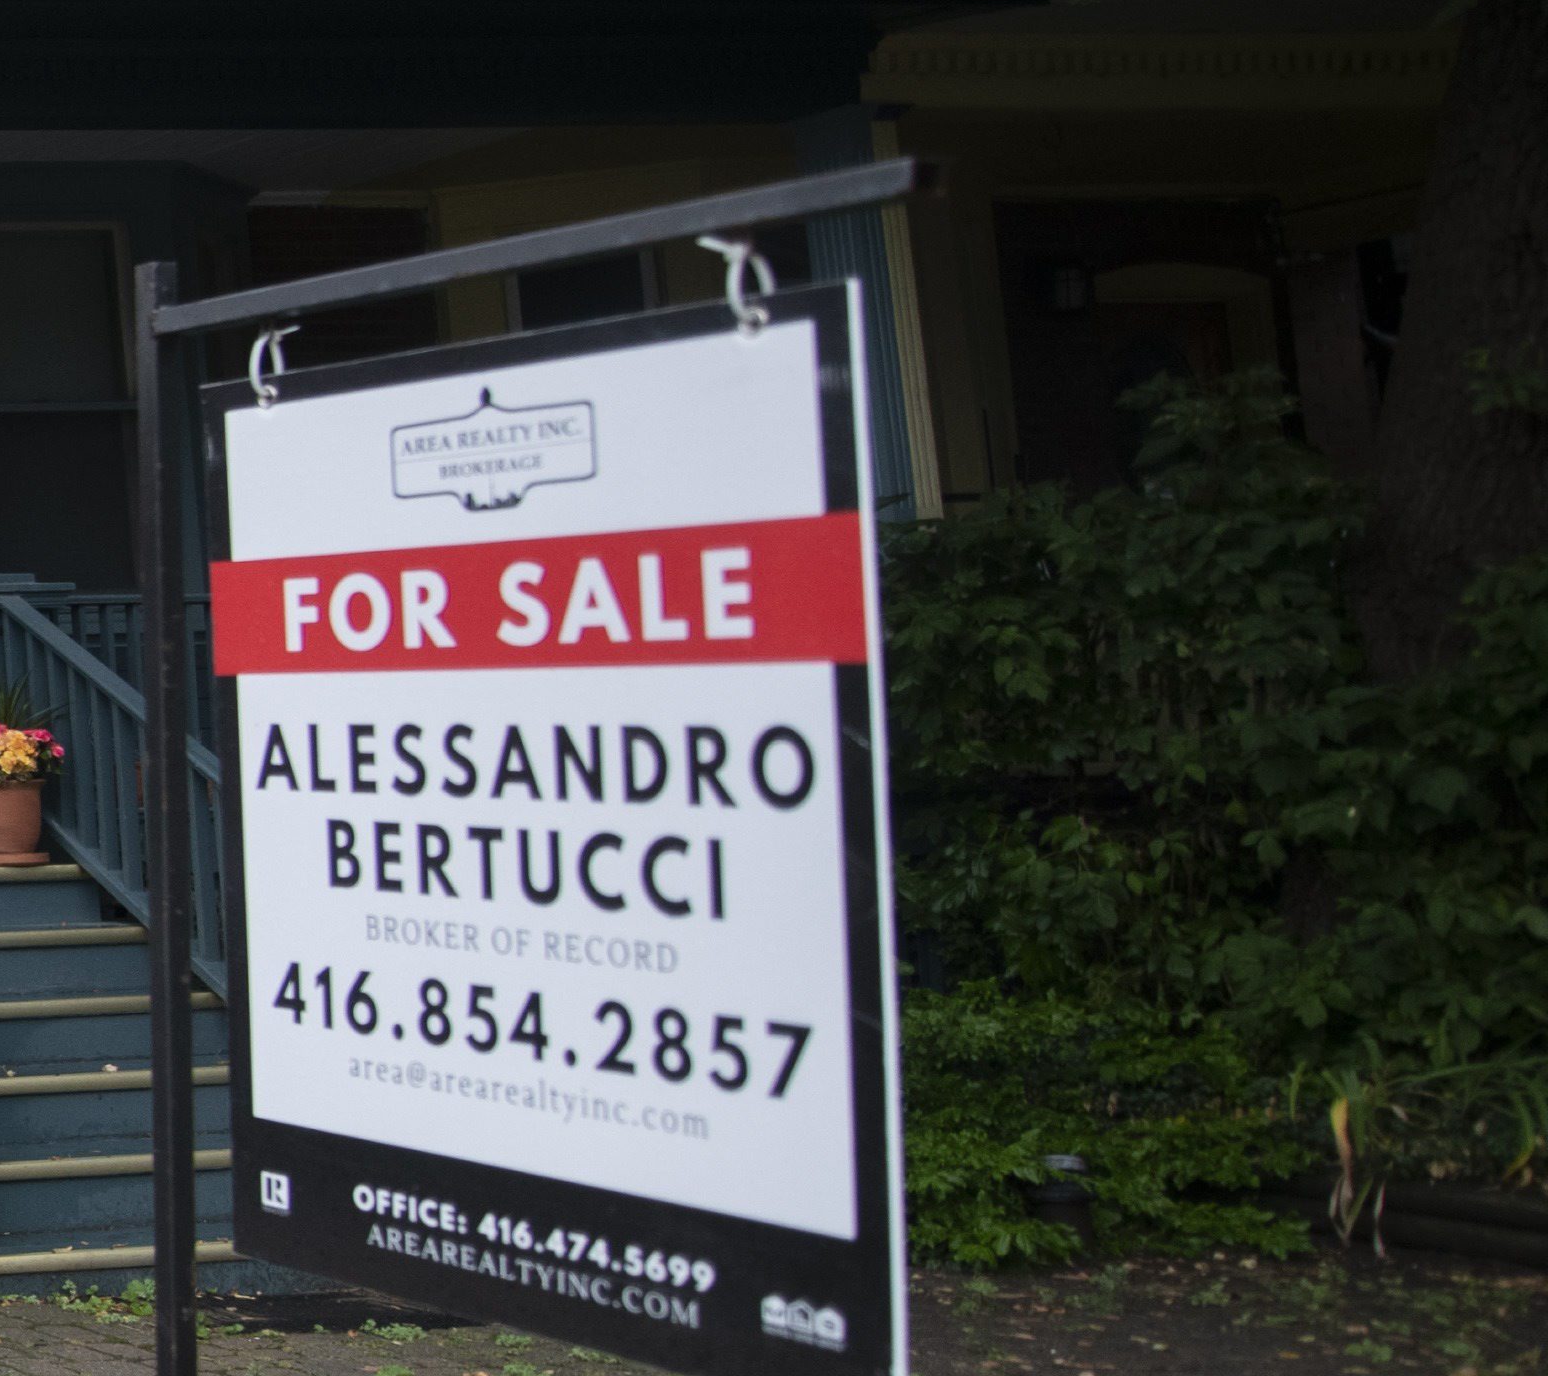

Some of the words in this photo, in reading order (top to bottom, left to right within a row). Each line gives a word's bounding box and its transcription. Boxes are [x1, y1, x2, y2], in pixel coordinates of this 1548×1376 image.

[401, 433, 452, 457] AREA
[457, 423, 533, 450] REALTY
[538, 416, 583, 438] INC.
[438, 453, 544, 480] BROKERAGE
[282, 568, 457, 652] FOR
[496, 546, 754, 647] SALE
[256, 722, 815, 811] ALESSANDRO
[326, 818, 726, 921] BERTUCCI
[365, 914, 480, 953] BROKER
[491, 926, 531, 958] OF
[543, 931, 680, 975] RECORD
[273, 961, 813, 1098] 416.854.2857
[348, 1056, 710, 1141] area@arearealtyinc.com
[352, 1182, 468, 1236] OFFICE:
[477, 1212, 717, 1293] 416.474.5699
[366, 1223, 702, 1329] AREAREALTYINC.COM
